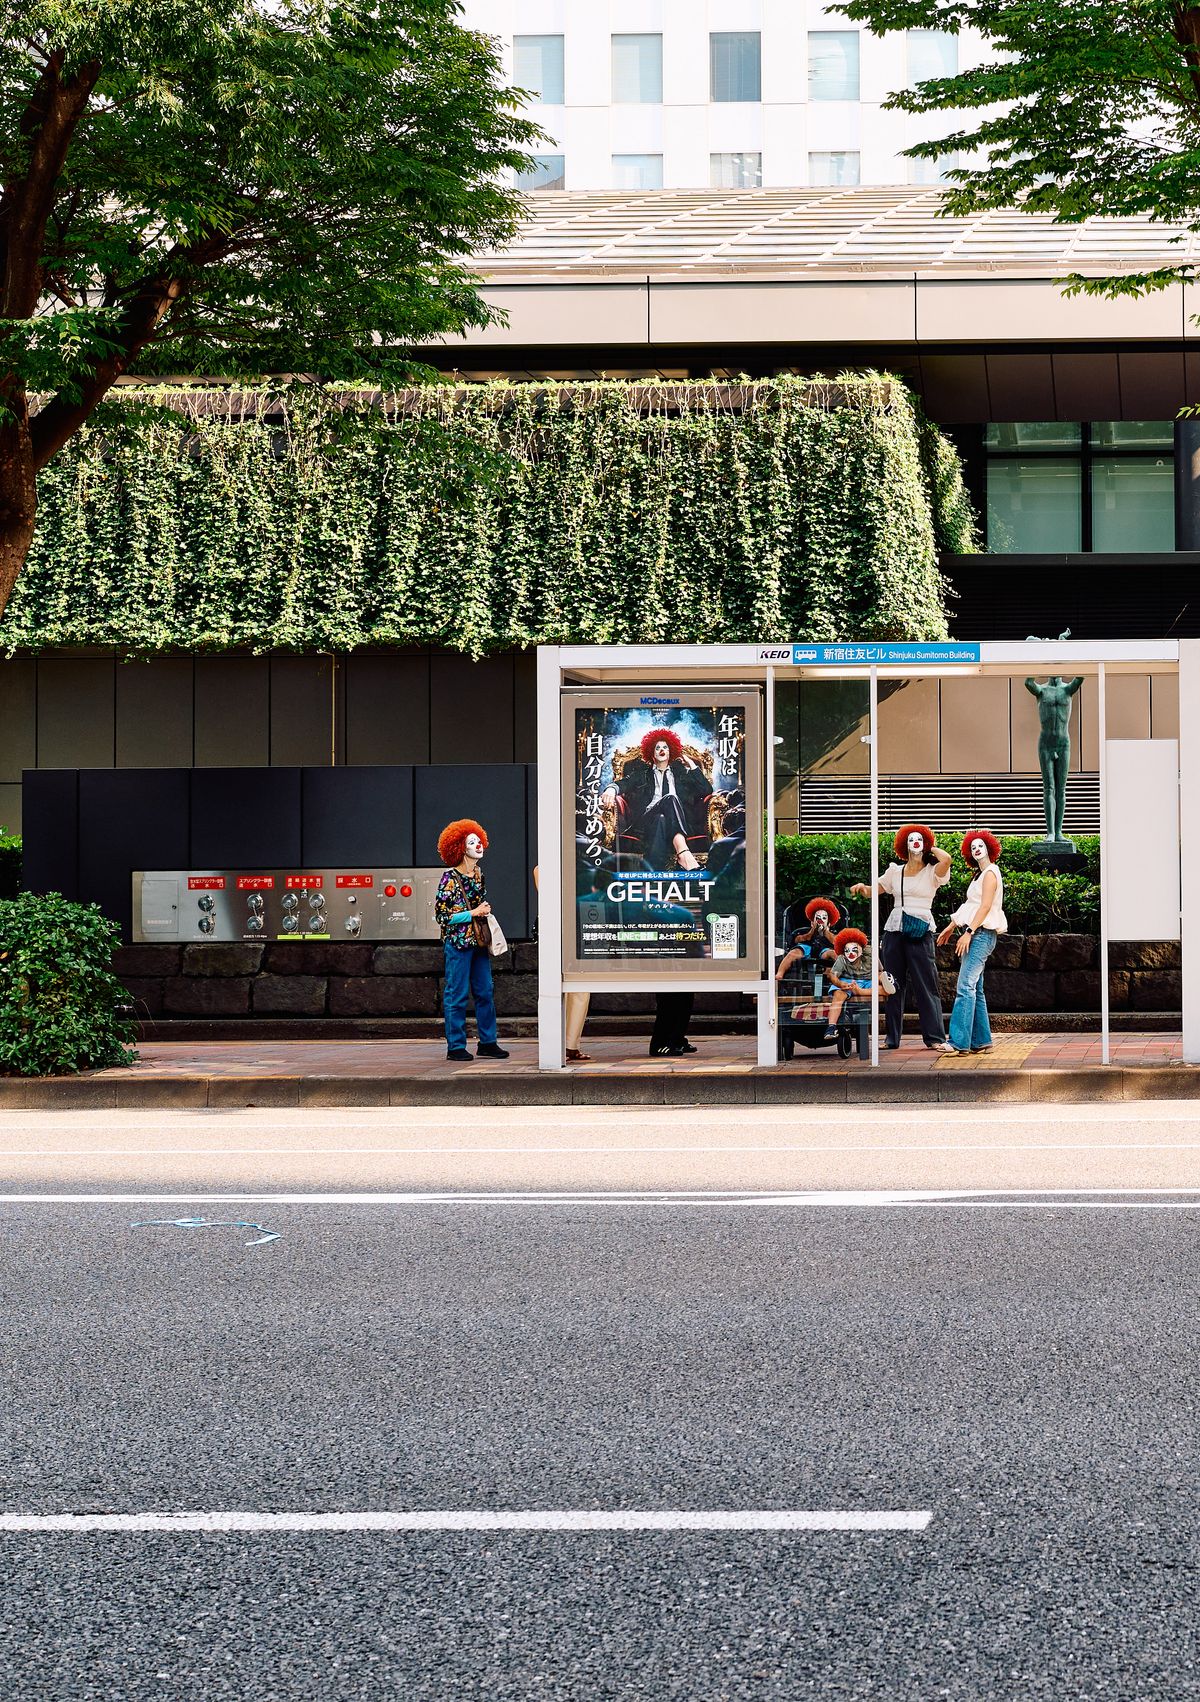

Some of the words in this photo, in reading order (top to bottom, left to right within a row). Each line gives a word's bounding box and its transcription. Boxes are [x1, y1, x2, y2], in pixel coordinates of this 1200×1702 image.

[760, 650, 790, 658] KEIO
[823, 648, 886, 660] 新宿住友ビル
[888, 651, 916, 660] Shinjuku
[917, 651, 948, 659] Sumitomo
[949, 651, 975, 660] Building
[640, 697, 680, 705] MCDecaux
[718, 714, 739, 776] 年収は
[584, 733, 605, 866] 自分で決めろ。
[606, 881, 715, 902] GEHALT
